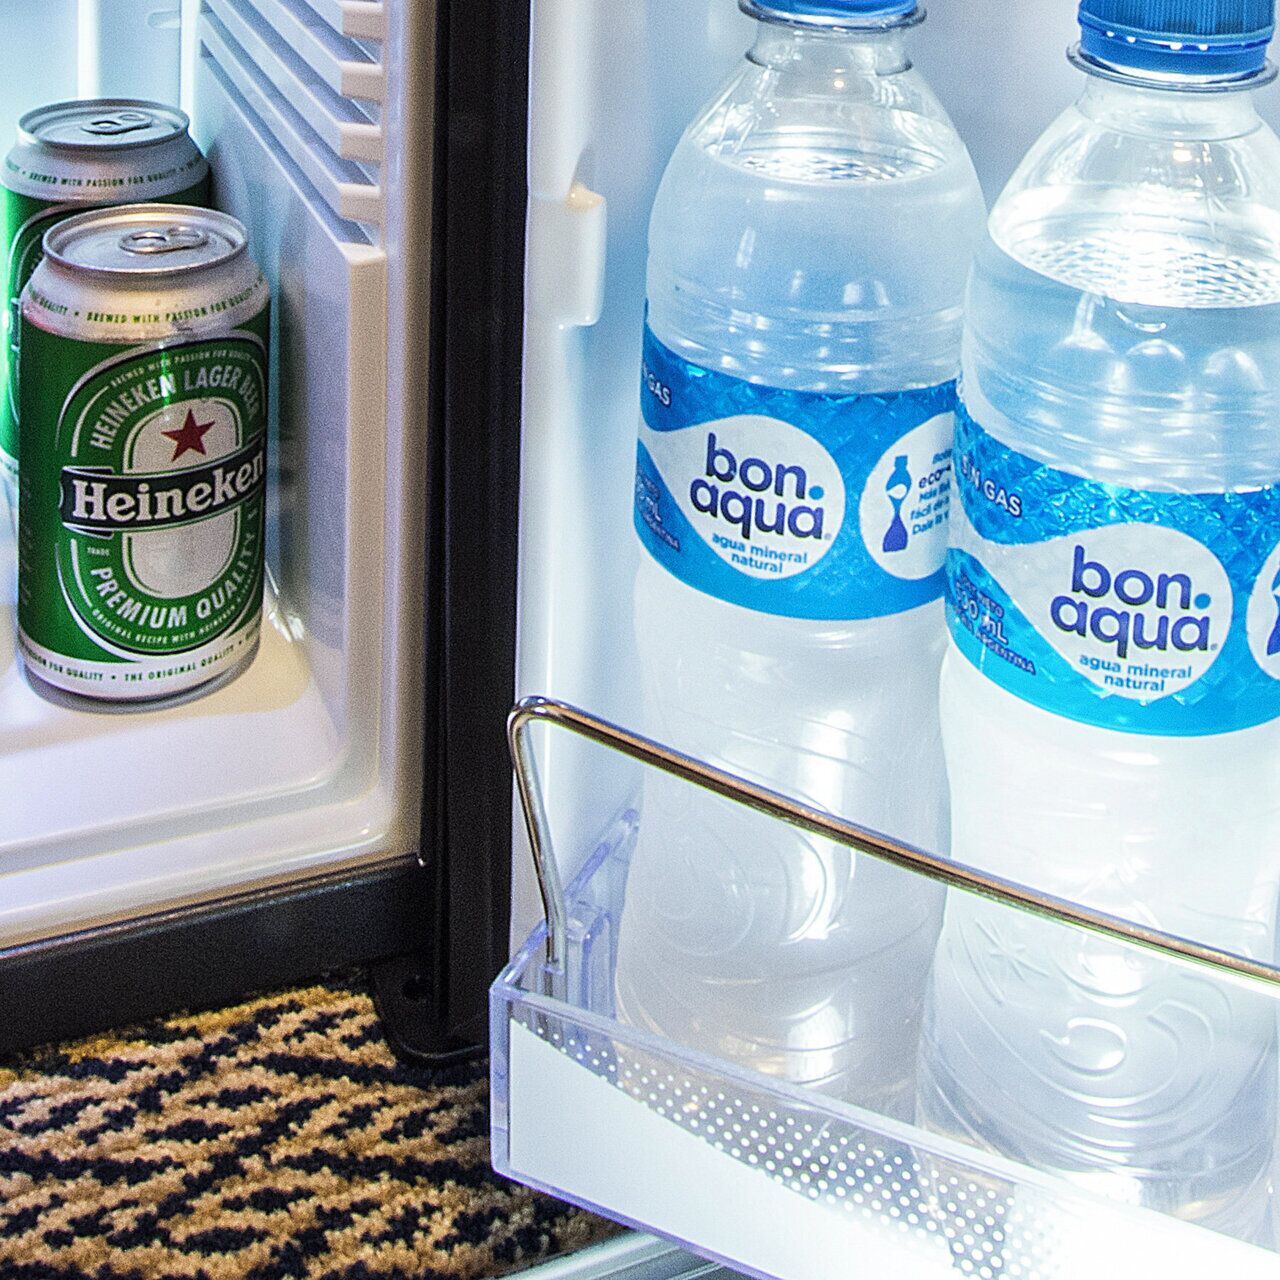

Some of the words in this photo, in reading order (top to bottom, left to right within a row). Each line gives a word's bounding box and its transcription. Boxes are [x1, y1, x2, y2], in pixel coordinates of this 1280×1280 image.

[90, 372, 176, 450] HEINEKEN
[184, 365, 243, 392] LAGER
[72, 453, 265, 522] Heineken
[690, 477, 823, 540] aqua
[984, 475, 1022, 517] GAS
[712, 531, 747, 555] agua
[751, 539, 808, 564] mineral
[731, 553, 783, 574] natural
[91, 567, 187, 629] PREMIUM
[196, 533, 255, 619] QUALITY
[1050, 595, 1210, 659] aqua
[124, 673, 143, 683] THE
[148, 663, 197, 680] ORIGINAL
[1079, 653, 1121, 674] agua
[1127, 657, 1192, 679] mineral
[1104, 674, 1165, 692] natural
